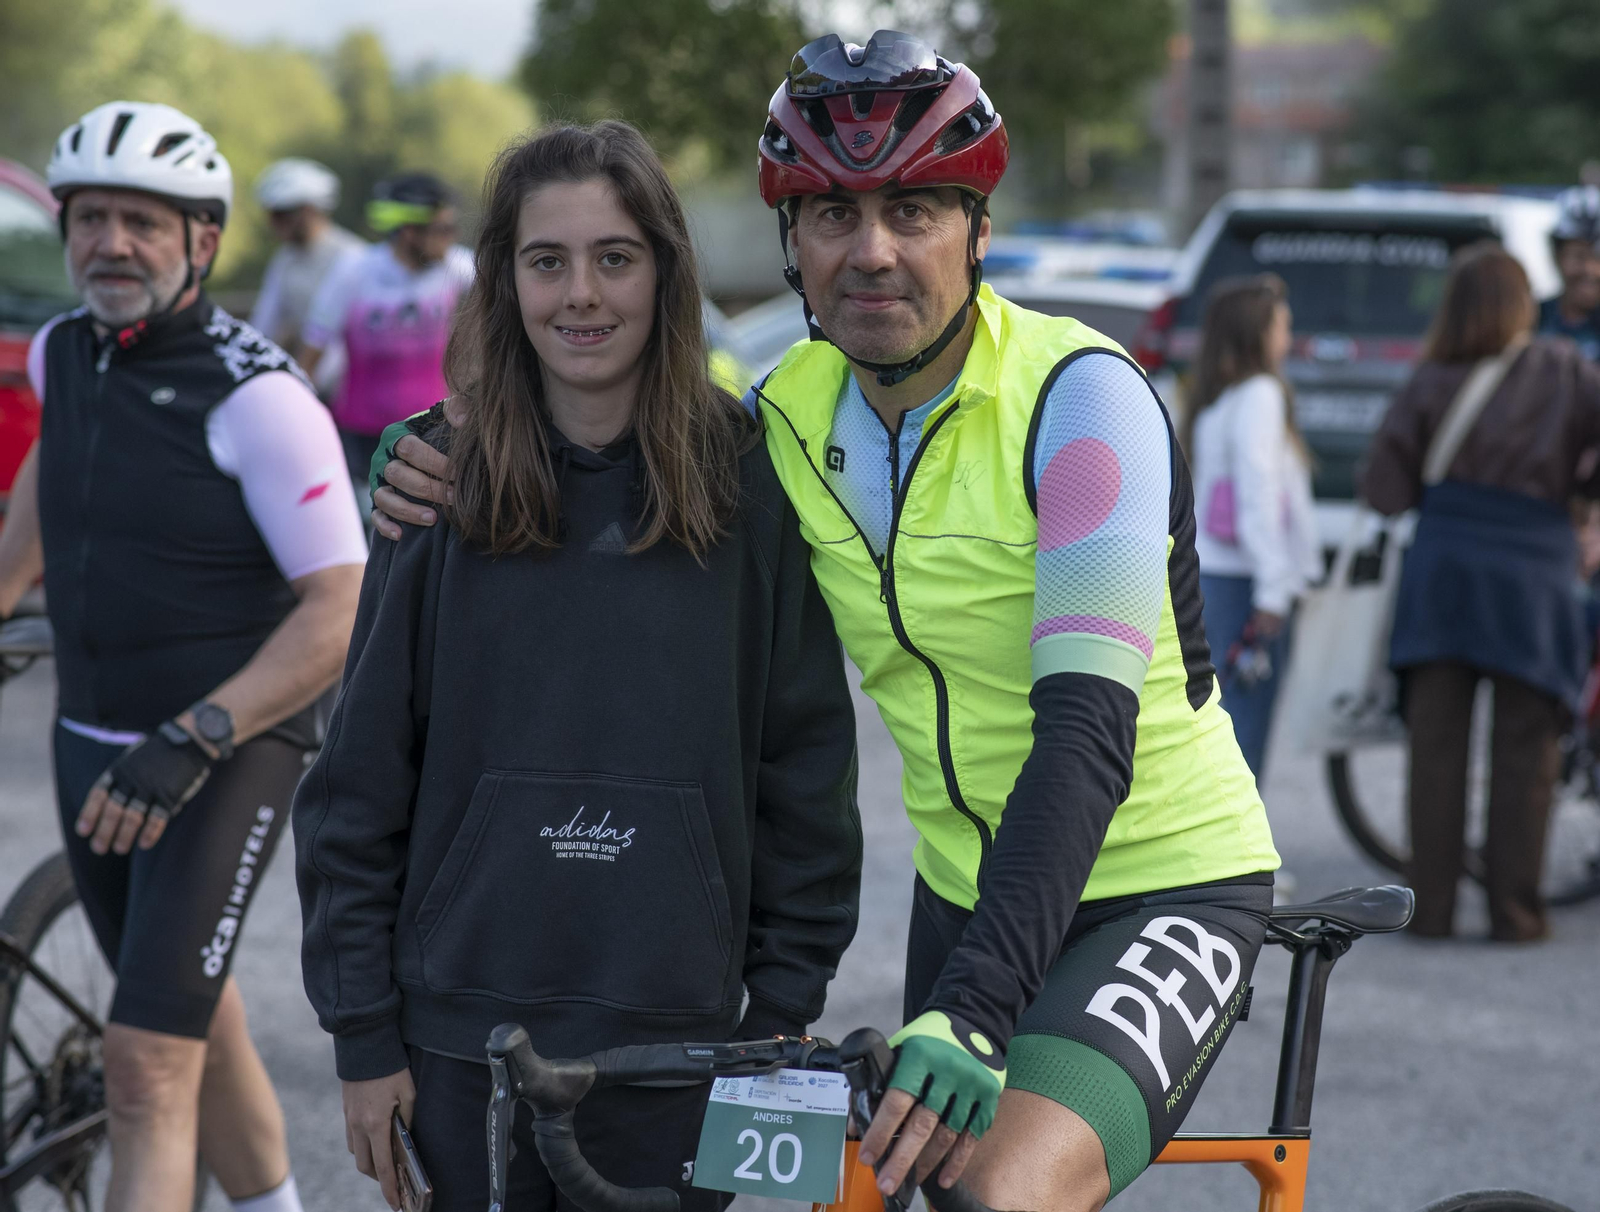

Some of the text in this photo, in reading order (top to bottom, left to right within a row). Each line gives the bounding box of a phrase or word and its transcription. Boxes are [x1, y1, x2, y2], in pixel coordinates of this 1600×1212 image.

[540, 806, 636, 848] adidas
[551, 841, 620, 854] FOUNDATION OF SPORT
[228, 805, 275, 905] HOTELS
[584, 852, 598, 860] THREE
[598, 854, 615, 862] STRIPES
[1165, 1085, 1182, 1113] PRO
[1183, 1036, 1214, 1090] EVASION
[1214, 1012, 1230, 1043] BIKE
[752, 1111, 793, 1125] ANDRES
[733, 1128, 803, 1184] 20
